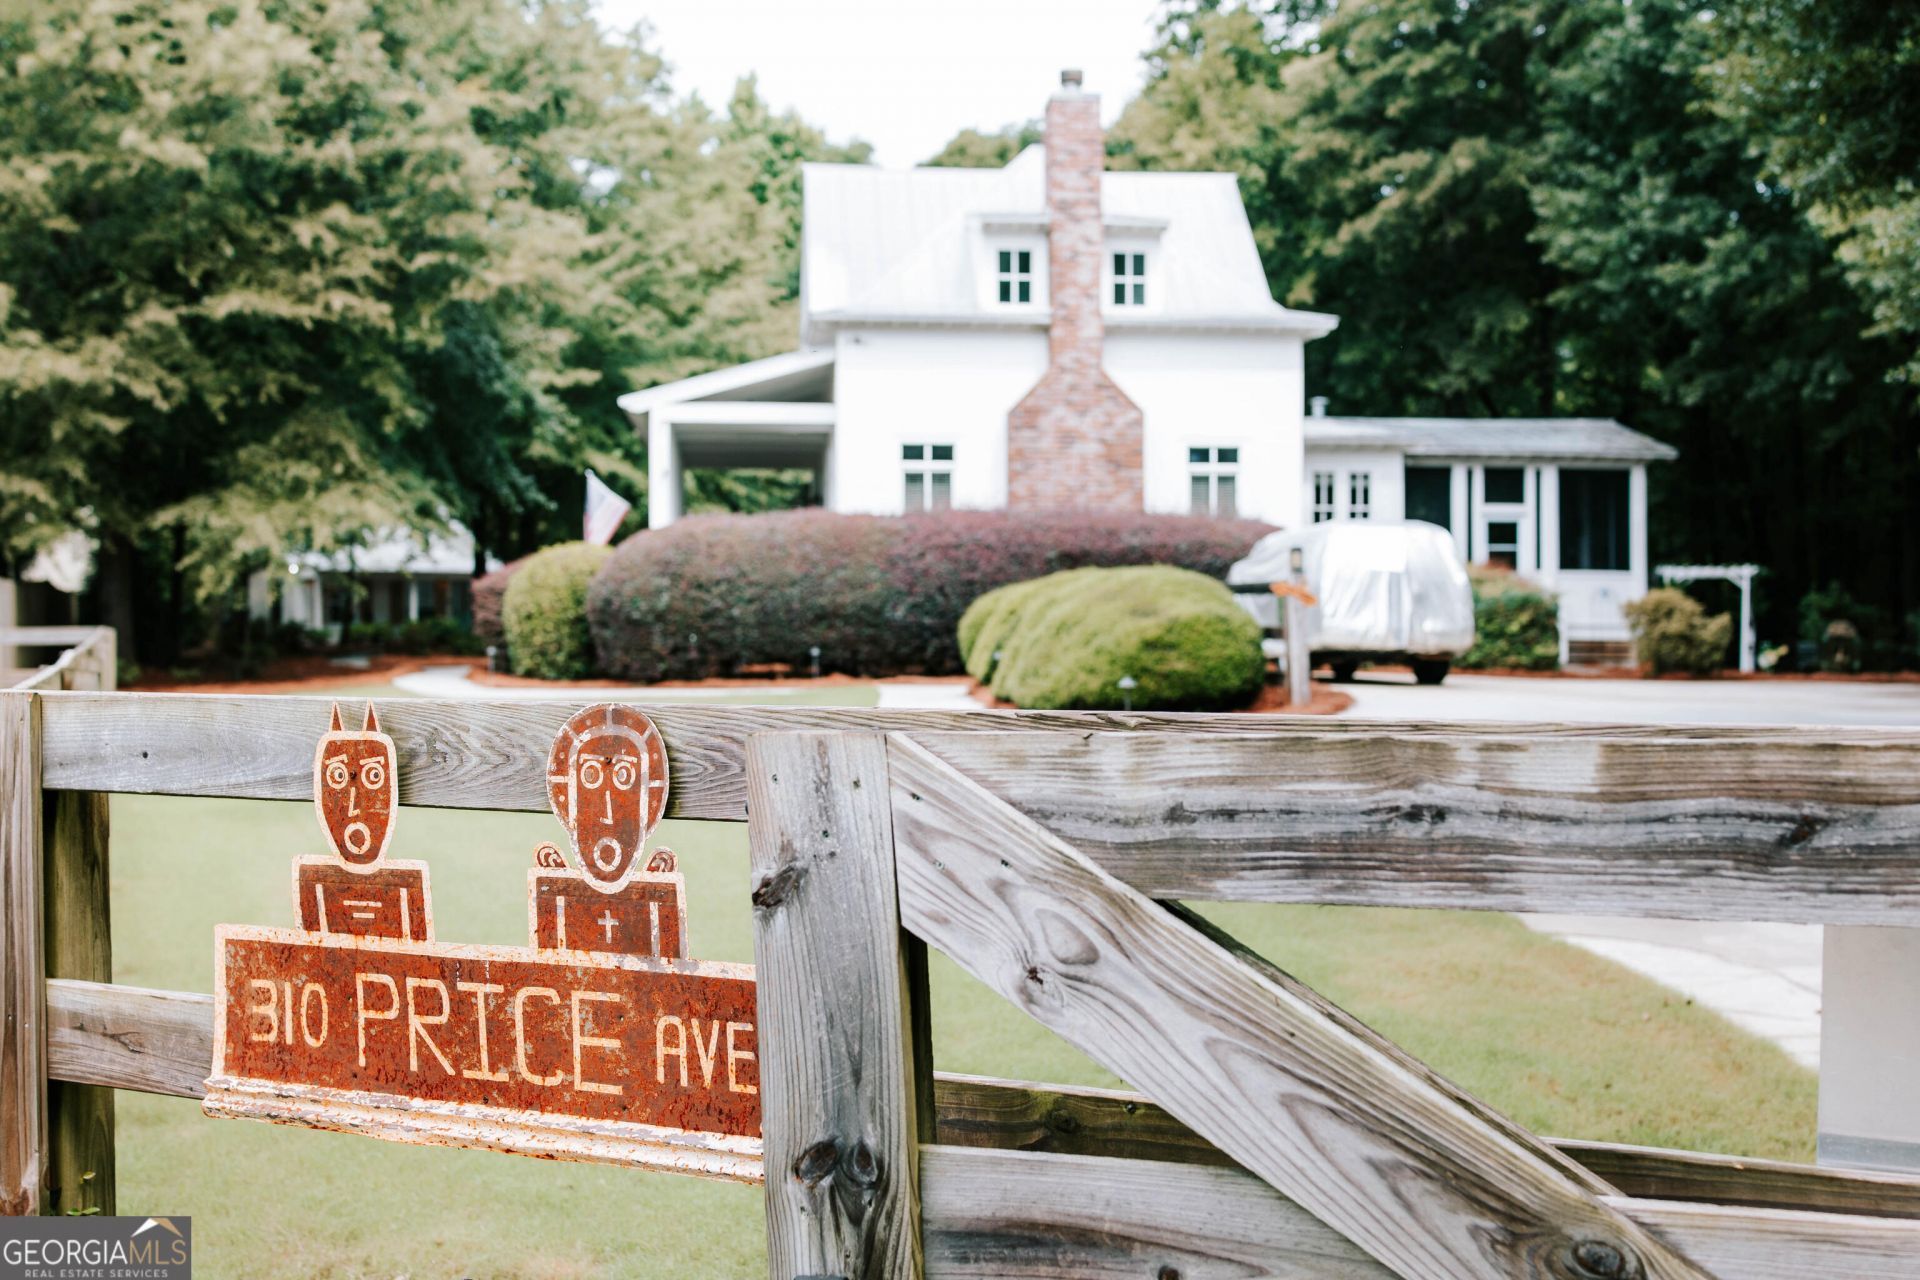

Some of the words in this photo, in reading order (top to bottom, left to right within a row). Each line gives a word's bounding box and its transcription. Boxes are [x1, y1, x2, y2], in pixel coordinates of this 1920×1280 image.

[249, 978, 328, 1049] 310
[355, 971, 624, 1097] PRICE
[655, 1014, 758, 1095] AVE
